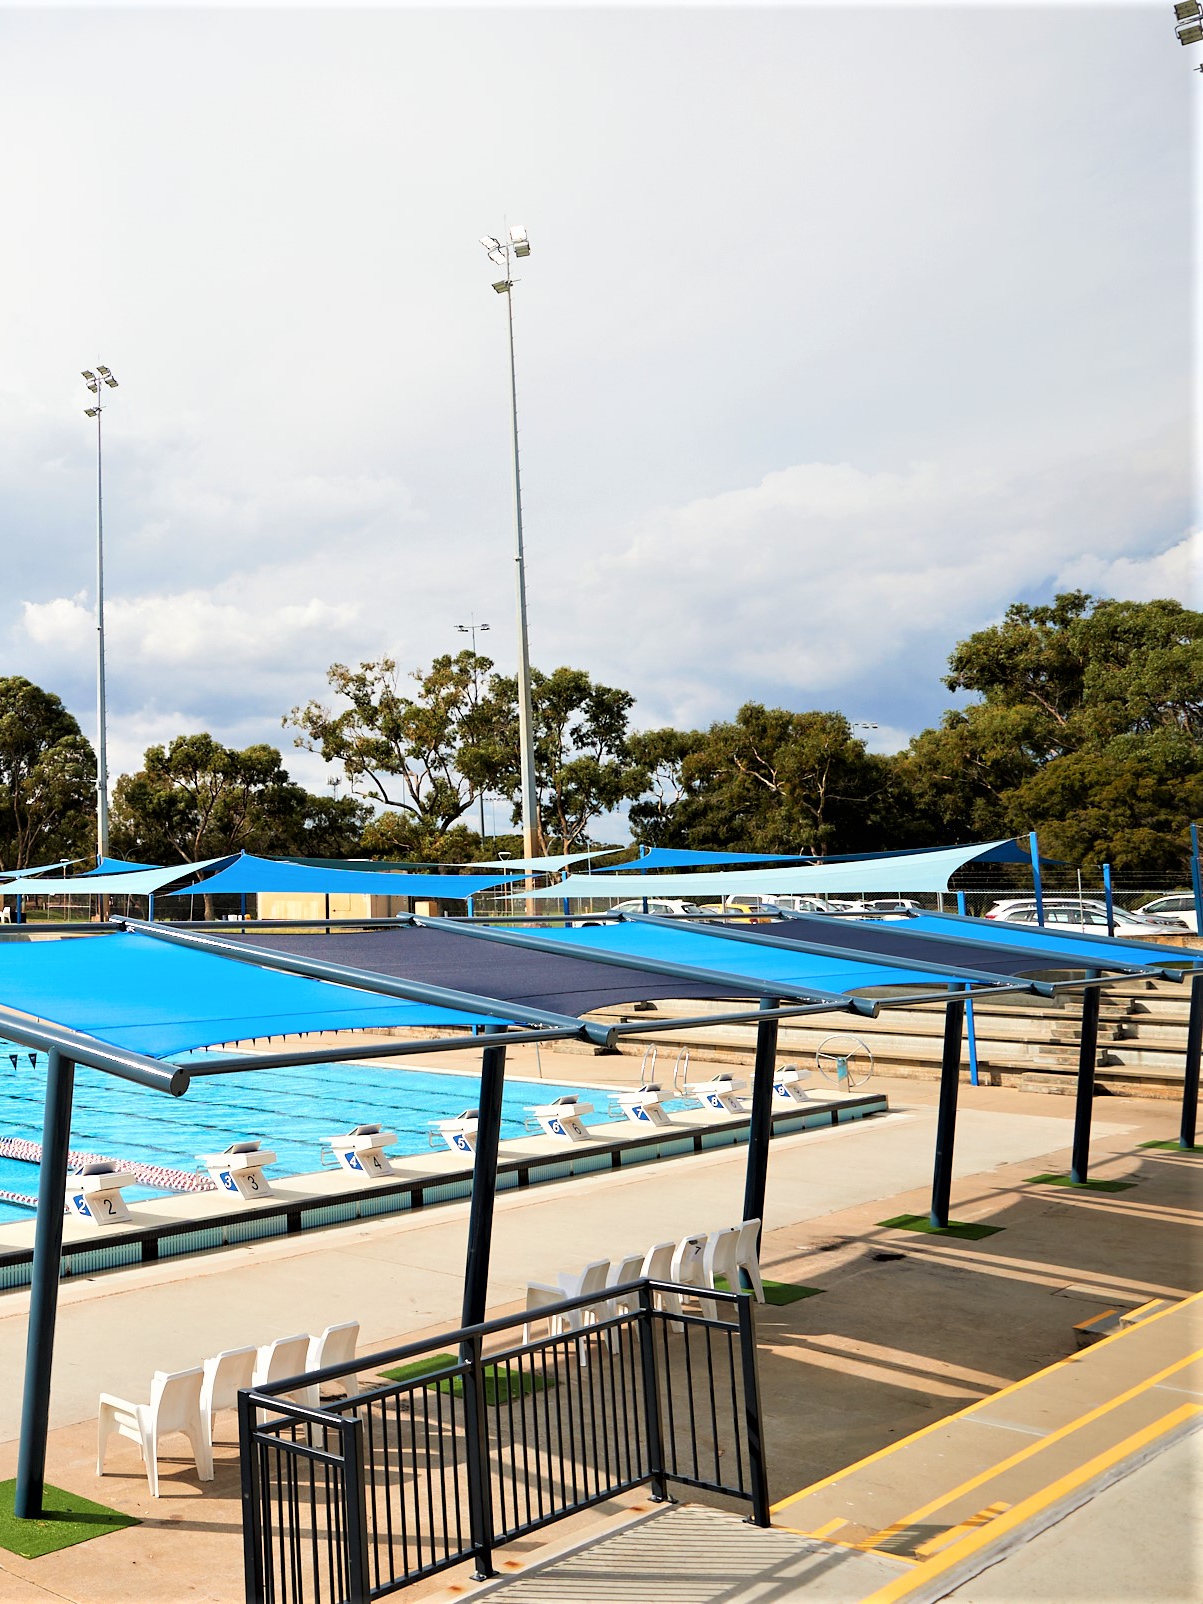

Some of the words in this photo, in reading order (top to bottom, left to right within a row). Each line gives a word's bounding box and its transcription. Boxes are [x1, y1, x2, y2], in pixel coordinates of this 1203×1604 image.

[778, 1086, 785, 1096] 9
[711, 1096, 718, 1107] 8
[654, 1109, 663, 1121] 7
[552, 1122, 560, 1133] 6
[572, 1122, 582, 1135] 6
[458, 1137, 466, 1149] 5
[349, 1155, 358, 1168] 4
[373, 1156, 383, 1170] 4
[224, 1175, 232, 1189] 3
[247, 1175, 259, 1191] 3
[78, 1199, 87, 1214] 2
[103, 1199, 117, 1216] 2
